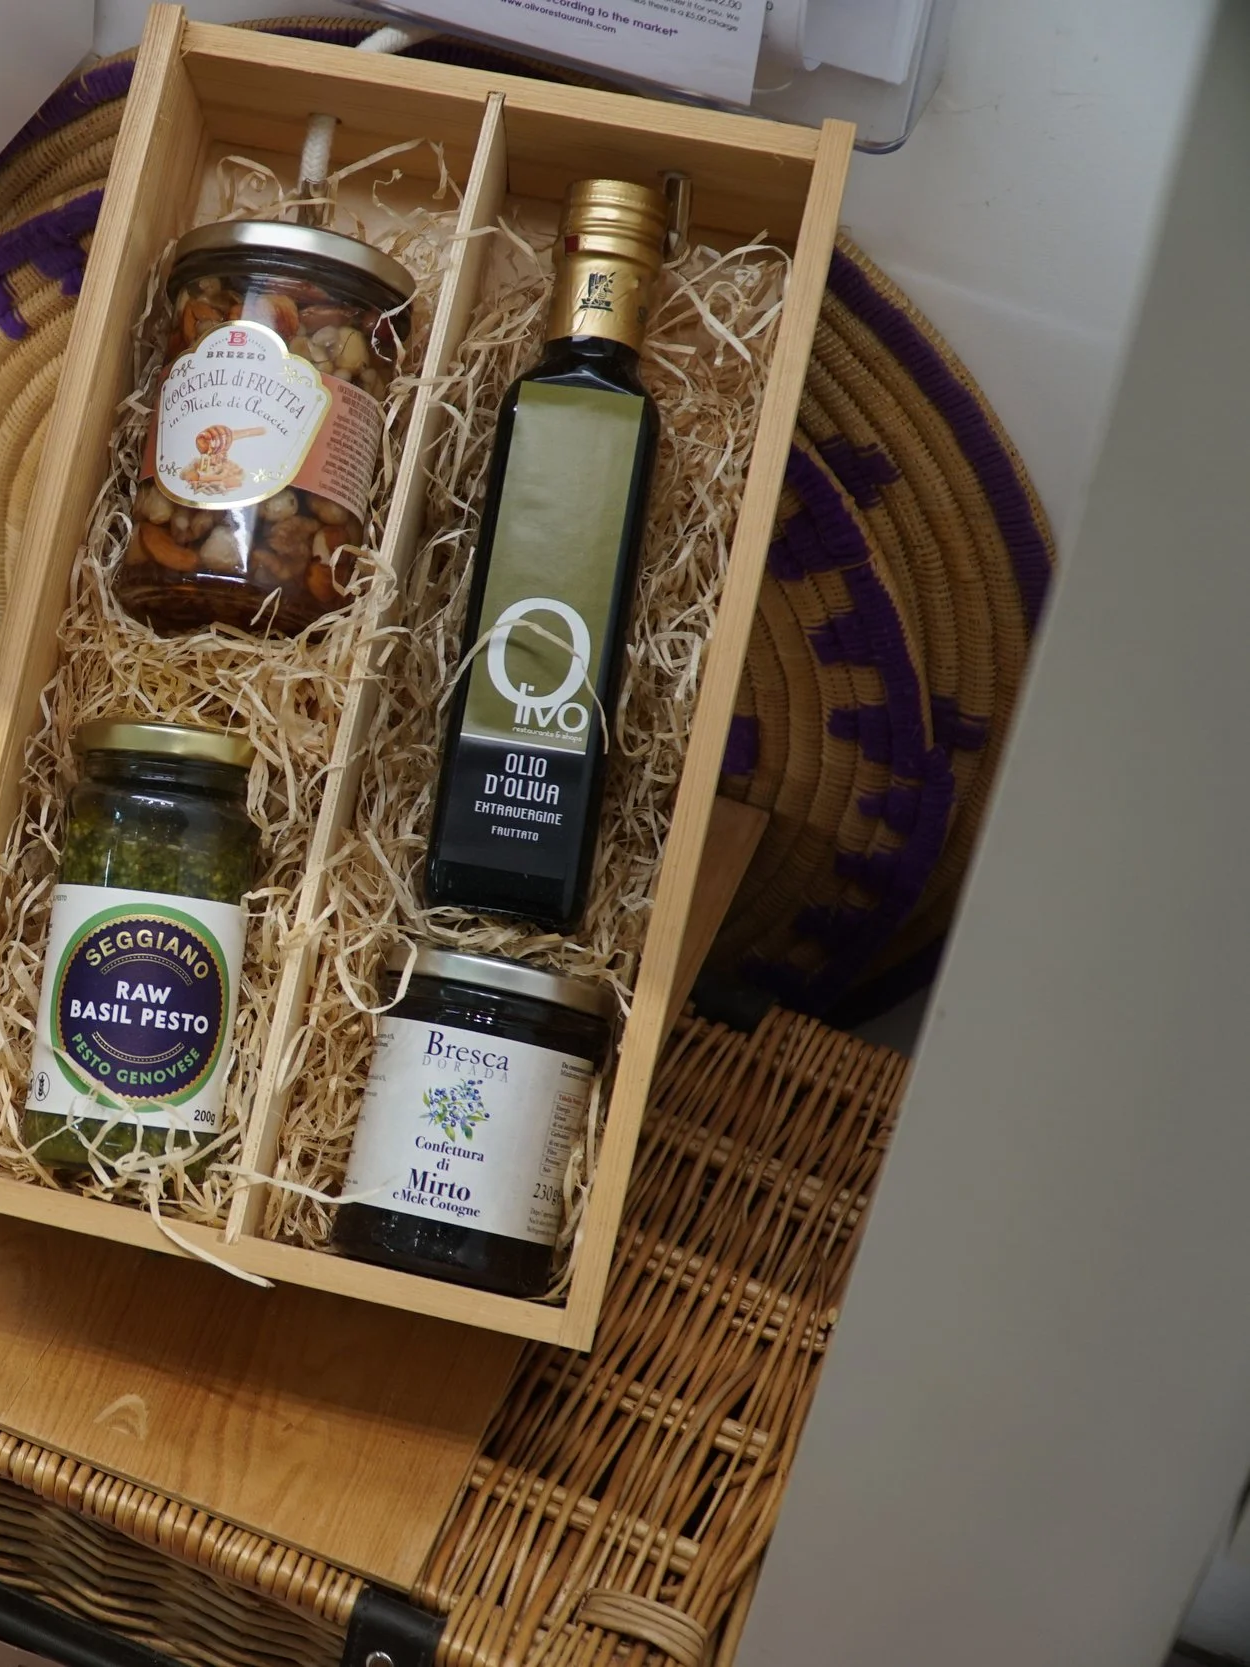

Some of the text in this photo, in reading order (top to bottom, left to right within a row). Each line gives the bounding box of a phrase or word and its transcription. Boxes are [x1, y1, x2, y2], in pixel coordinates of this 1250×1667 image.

[546, 0, 597, 17] cording
[598, 8, 610, 19] to
[611, 11, 630, 24] the
[708, 18, 740, 33] charge
[227, 330, 248, 346] B
[206, 350, 266, 361] BREZZO
[164, 368, 306, 420] COCKTAIL di FRUTTA
[168, 392, 289, 436] in Miele di Acacia
[512, 725, 555, 739] restaurants
[561, 731, 584, 744] shops
[504, 752, 548, 779] OLIO
[474, 800, 564, 826] EXTRAVERGINE
[491, 825, 540, 842] FRUTTATO
[85, 929, 210, 980] SEGGIANO
[115, 980, 172, 1005] RAW
[69, 999, 210, 1035] BASIL PESTO
[71, 1032, 201, 1086] PESTO GENOVESE
[424, 1029, 510, 1072] Bresca
[421, 1053, 510, 1084] DORADA
[193, 1109, 217, 1126] 200g
[414, 1135, 486, 1163] Confettura
[436, 1157, 450, 1171] di
[405, 1168, 471, 1202] Mirto
[392, 1187, 481, 1219] e Mele Cotogne
